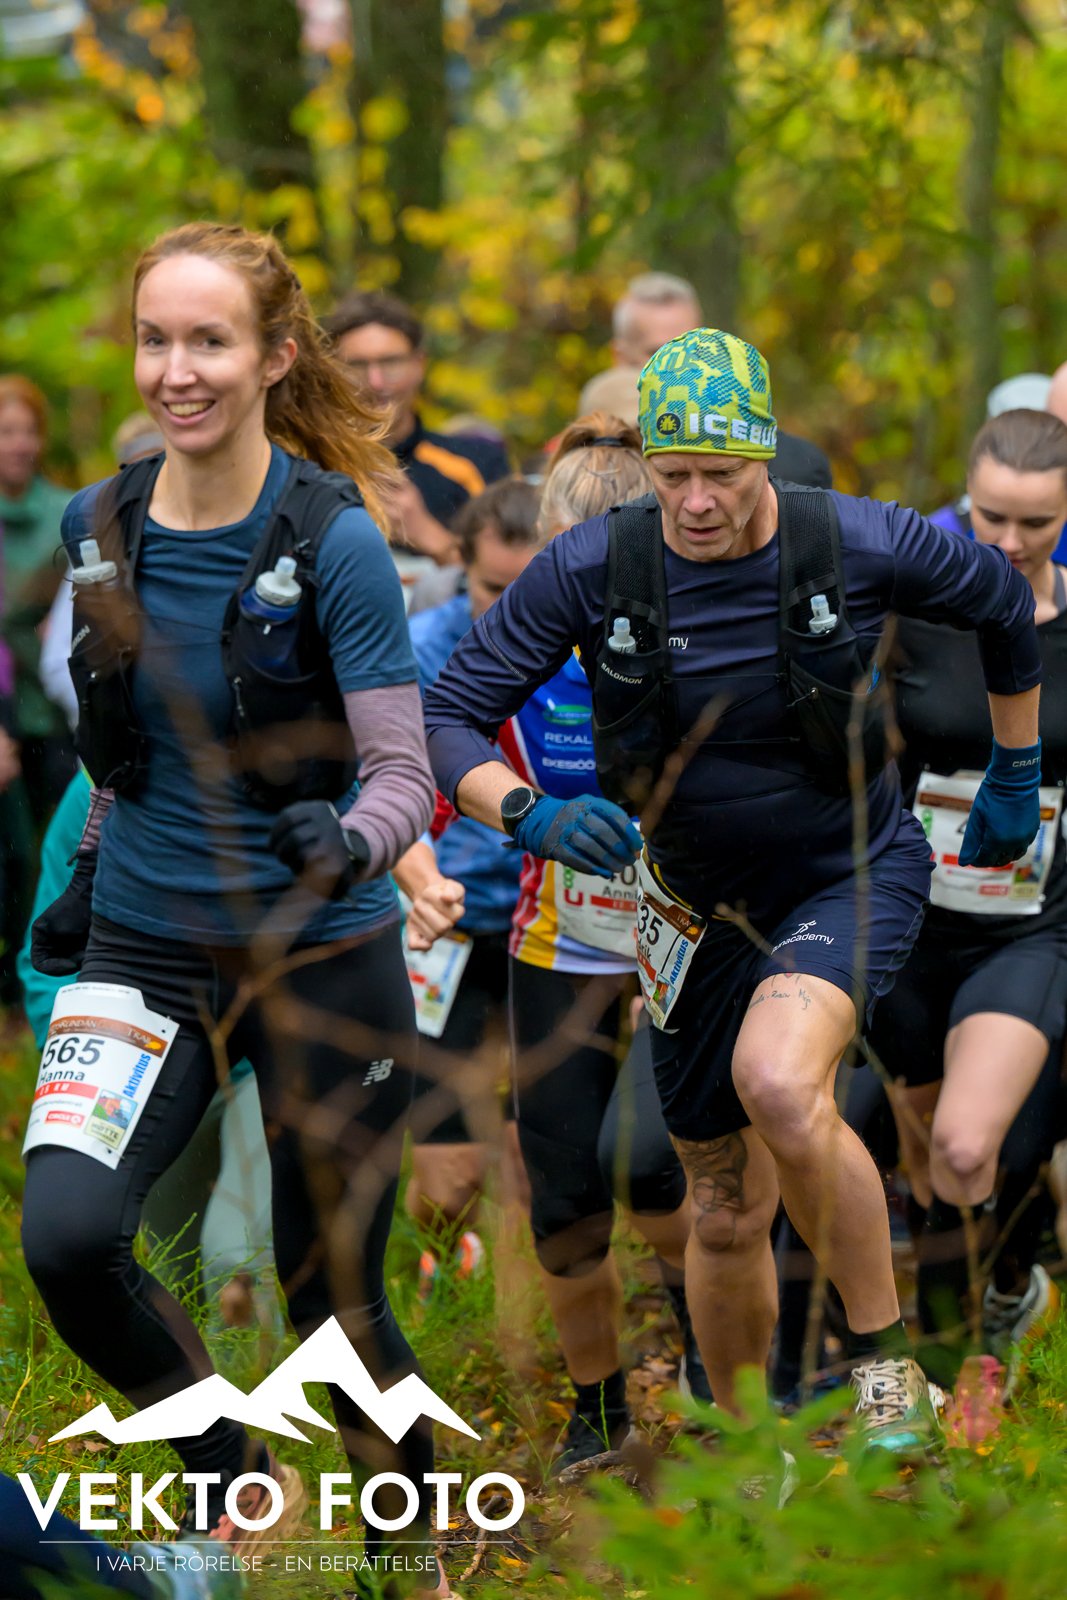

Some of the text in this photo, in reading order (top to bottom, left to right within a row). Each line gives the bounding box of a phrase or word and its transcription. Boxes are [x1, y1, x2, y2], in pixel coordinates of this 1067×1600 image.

[668, 636, 689, 650] my
[601, 662, 642, 685] SALOMON
[637, 904, 664, 946] 35
[42, 1036, 106, 1070] 565
[39, 1069, 86, 1085] Hanna
[122, 1052, 152, 1098] Aktivitus
